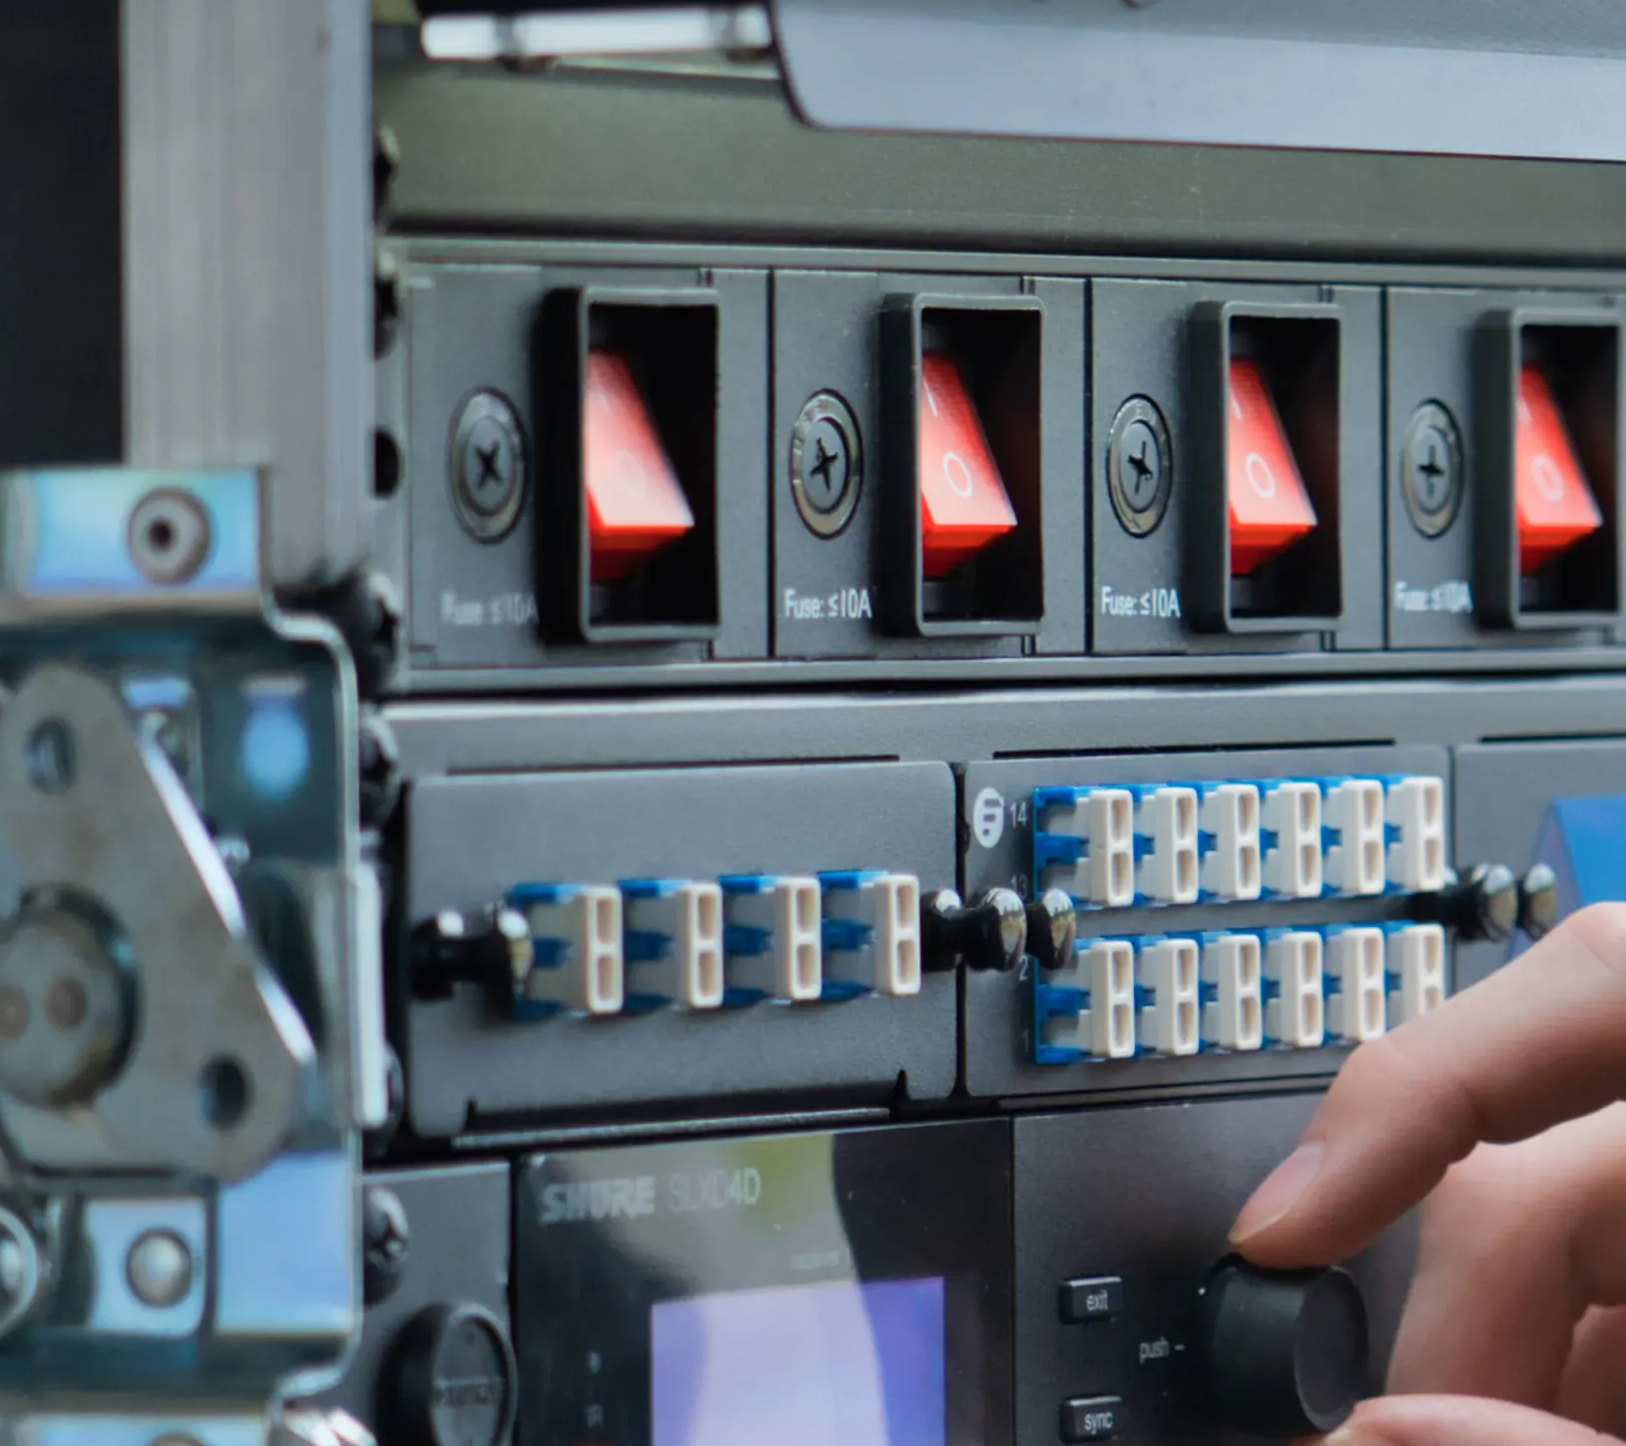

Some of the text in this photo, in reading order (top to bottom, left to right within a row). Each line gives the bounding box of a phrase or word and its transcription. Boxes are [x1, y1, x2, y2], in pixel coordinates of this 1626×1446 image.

[784, 587, 824, 619] Fuse:
[1101, 585, 1137, 616] Fuse:
[1010, 801, 1027, 829] 14
[541, 1176, 657, 1223] SHURE
[1086, 1290, 1109, 1311] exit
[1139, 1335, 1171, 1365] push
[1084, 1412, 1113, 1435] sync
